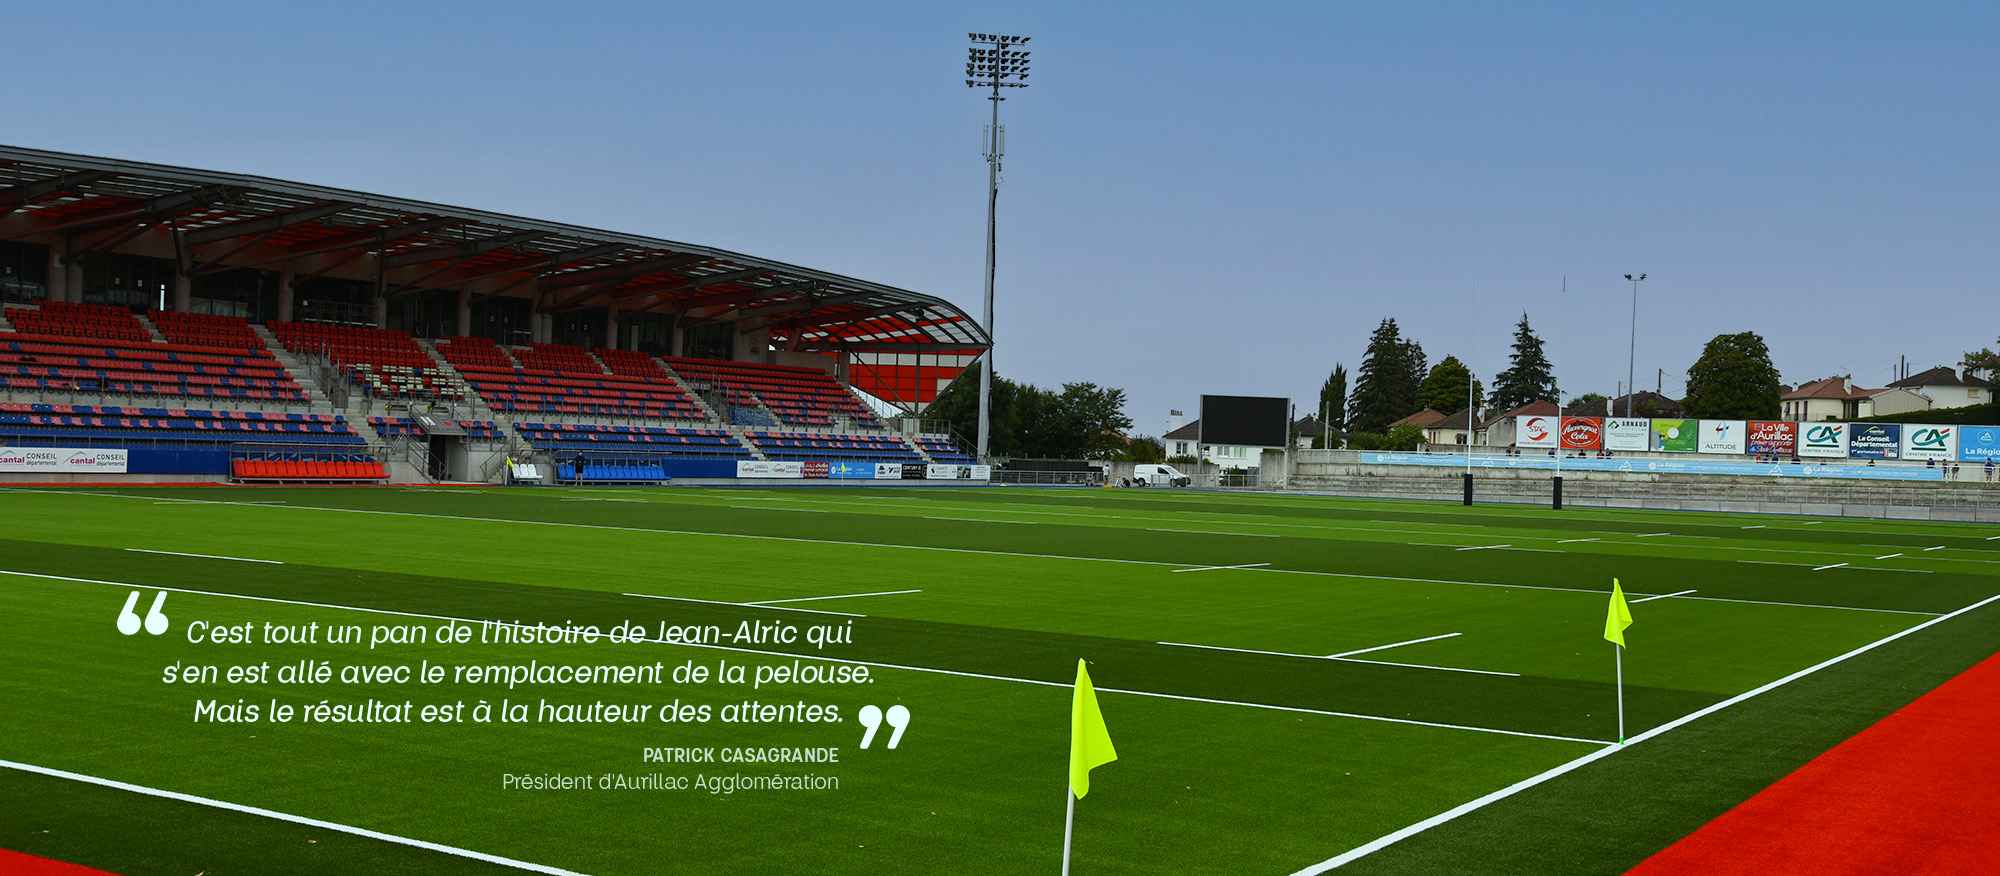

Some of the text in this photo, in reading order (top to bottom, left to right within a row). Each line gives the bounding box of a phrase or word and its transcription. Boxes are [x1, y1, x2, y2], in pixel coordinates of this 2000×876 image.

[1761, 423, 1789, 431] La Ville
[1570, 432, 1588, 441] Cola
[1750, 430, 1793, 440] d'Aurillac
[1965, 447, 1976, 455] La
[70, 457, 96, 465] cantal
